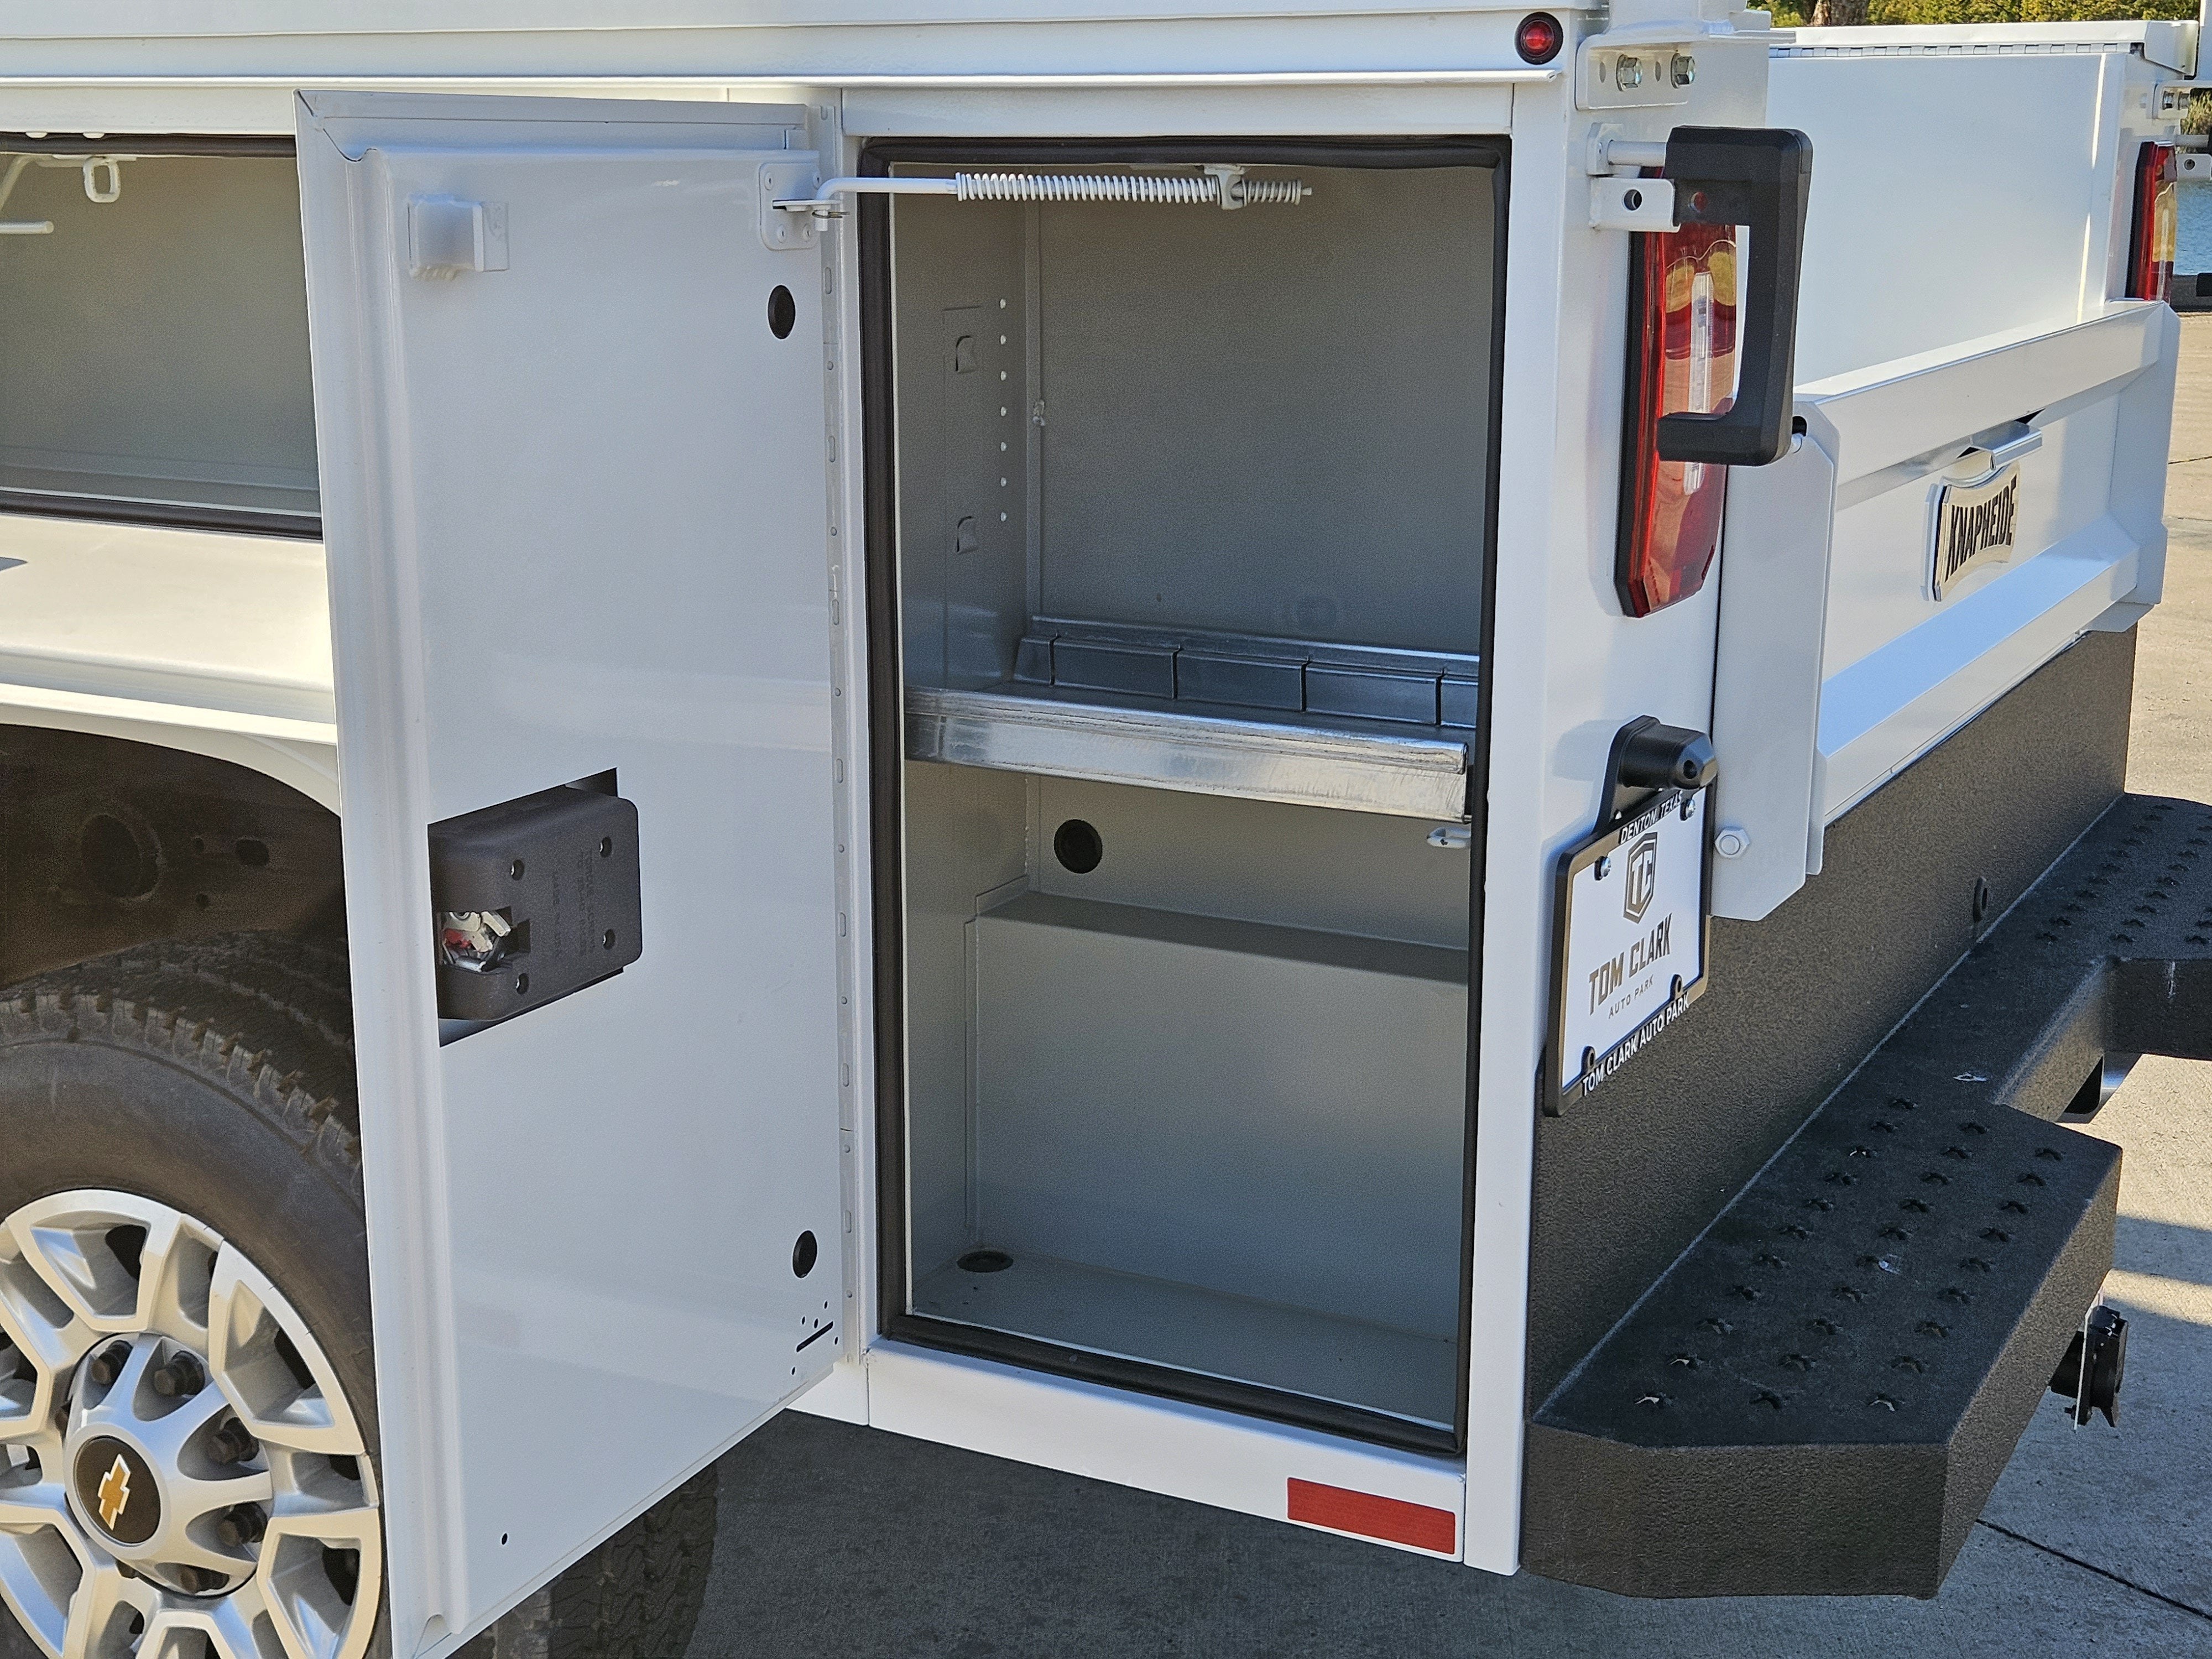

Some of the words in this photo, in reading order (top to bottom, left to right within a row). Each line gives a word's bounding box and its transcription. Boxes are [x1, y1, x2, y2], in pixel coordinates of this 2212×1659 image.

[1944, 474, 2017, 582] KNAPHEIDE
[1661, 790, 1682, 817] TEXAS
[1589, 952, 1625, 1016] TOM
[1629, 912, 1672, 978] CLARK
[1608, 994, 1631, 1019] AUTO
[1634, 974, 1653, 999] PARK
[1583, 1063, 1604, 1096] TOM
[1606, 1035, 1637, 1076] CLARK
[1639, 1014, 1664, 1048] AUTO
[1666, 992, 1689, 1025] PARK
